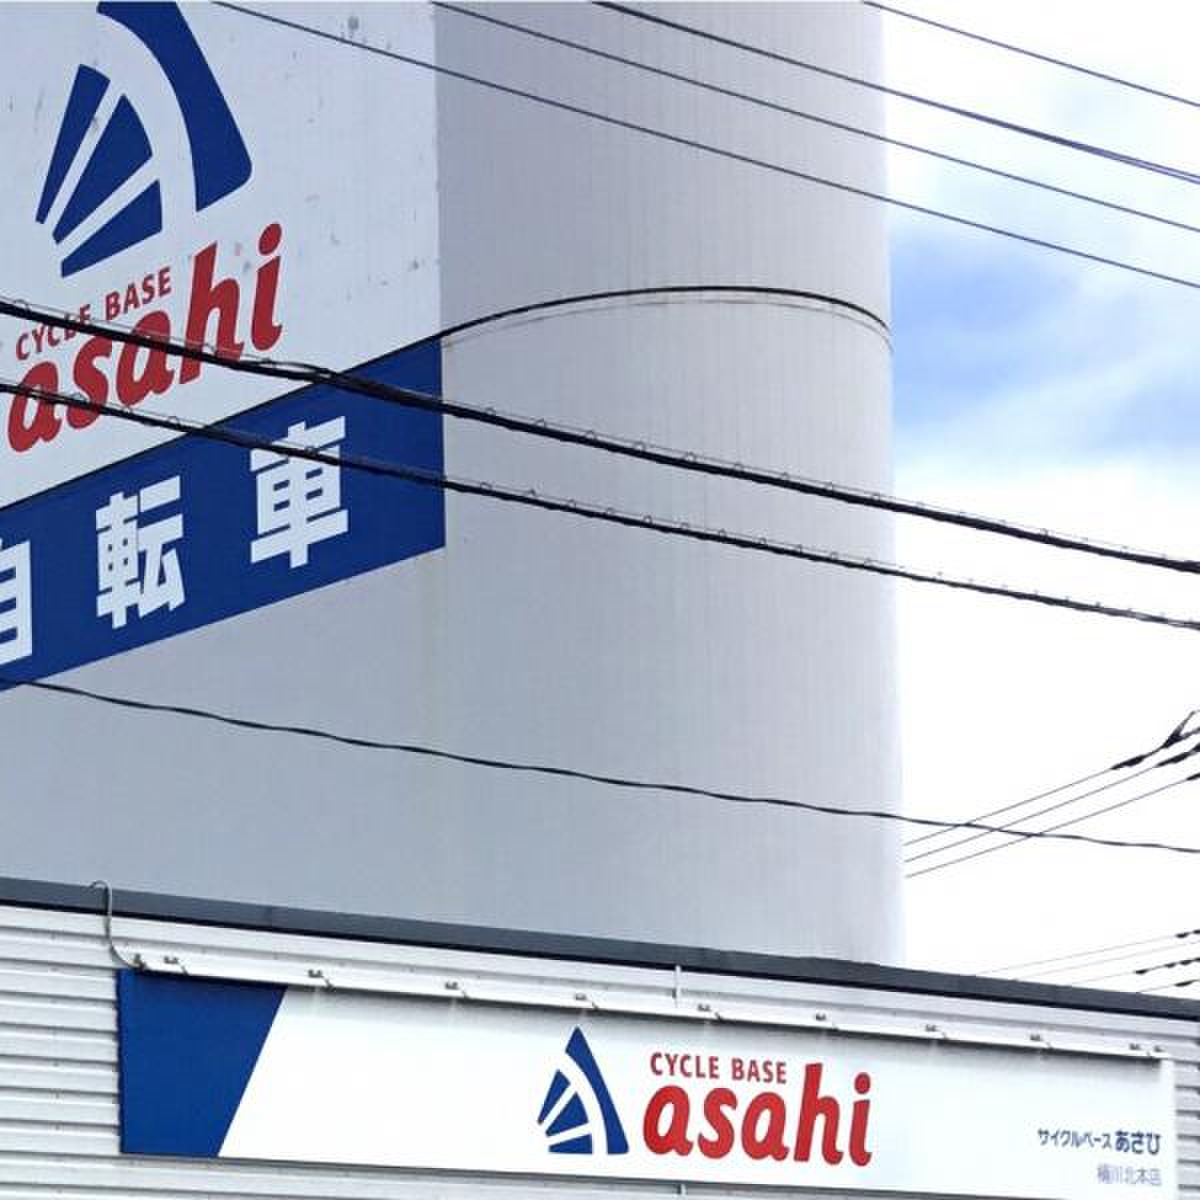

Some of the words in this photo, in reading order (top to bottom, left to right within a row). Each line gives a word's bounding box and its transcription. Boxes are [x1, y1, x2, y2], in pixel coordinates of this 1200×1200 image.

[8, 223, 282, 453] asahi
[16, 304, 91, 361] CYCLE
[104, 266, 172, 320] BASE
[643, 1063, 872, 1167] asahi
[650, 1052, 720, 1079] CYCLE
[731, 1057, 787, 1084] BASE
